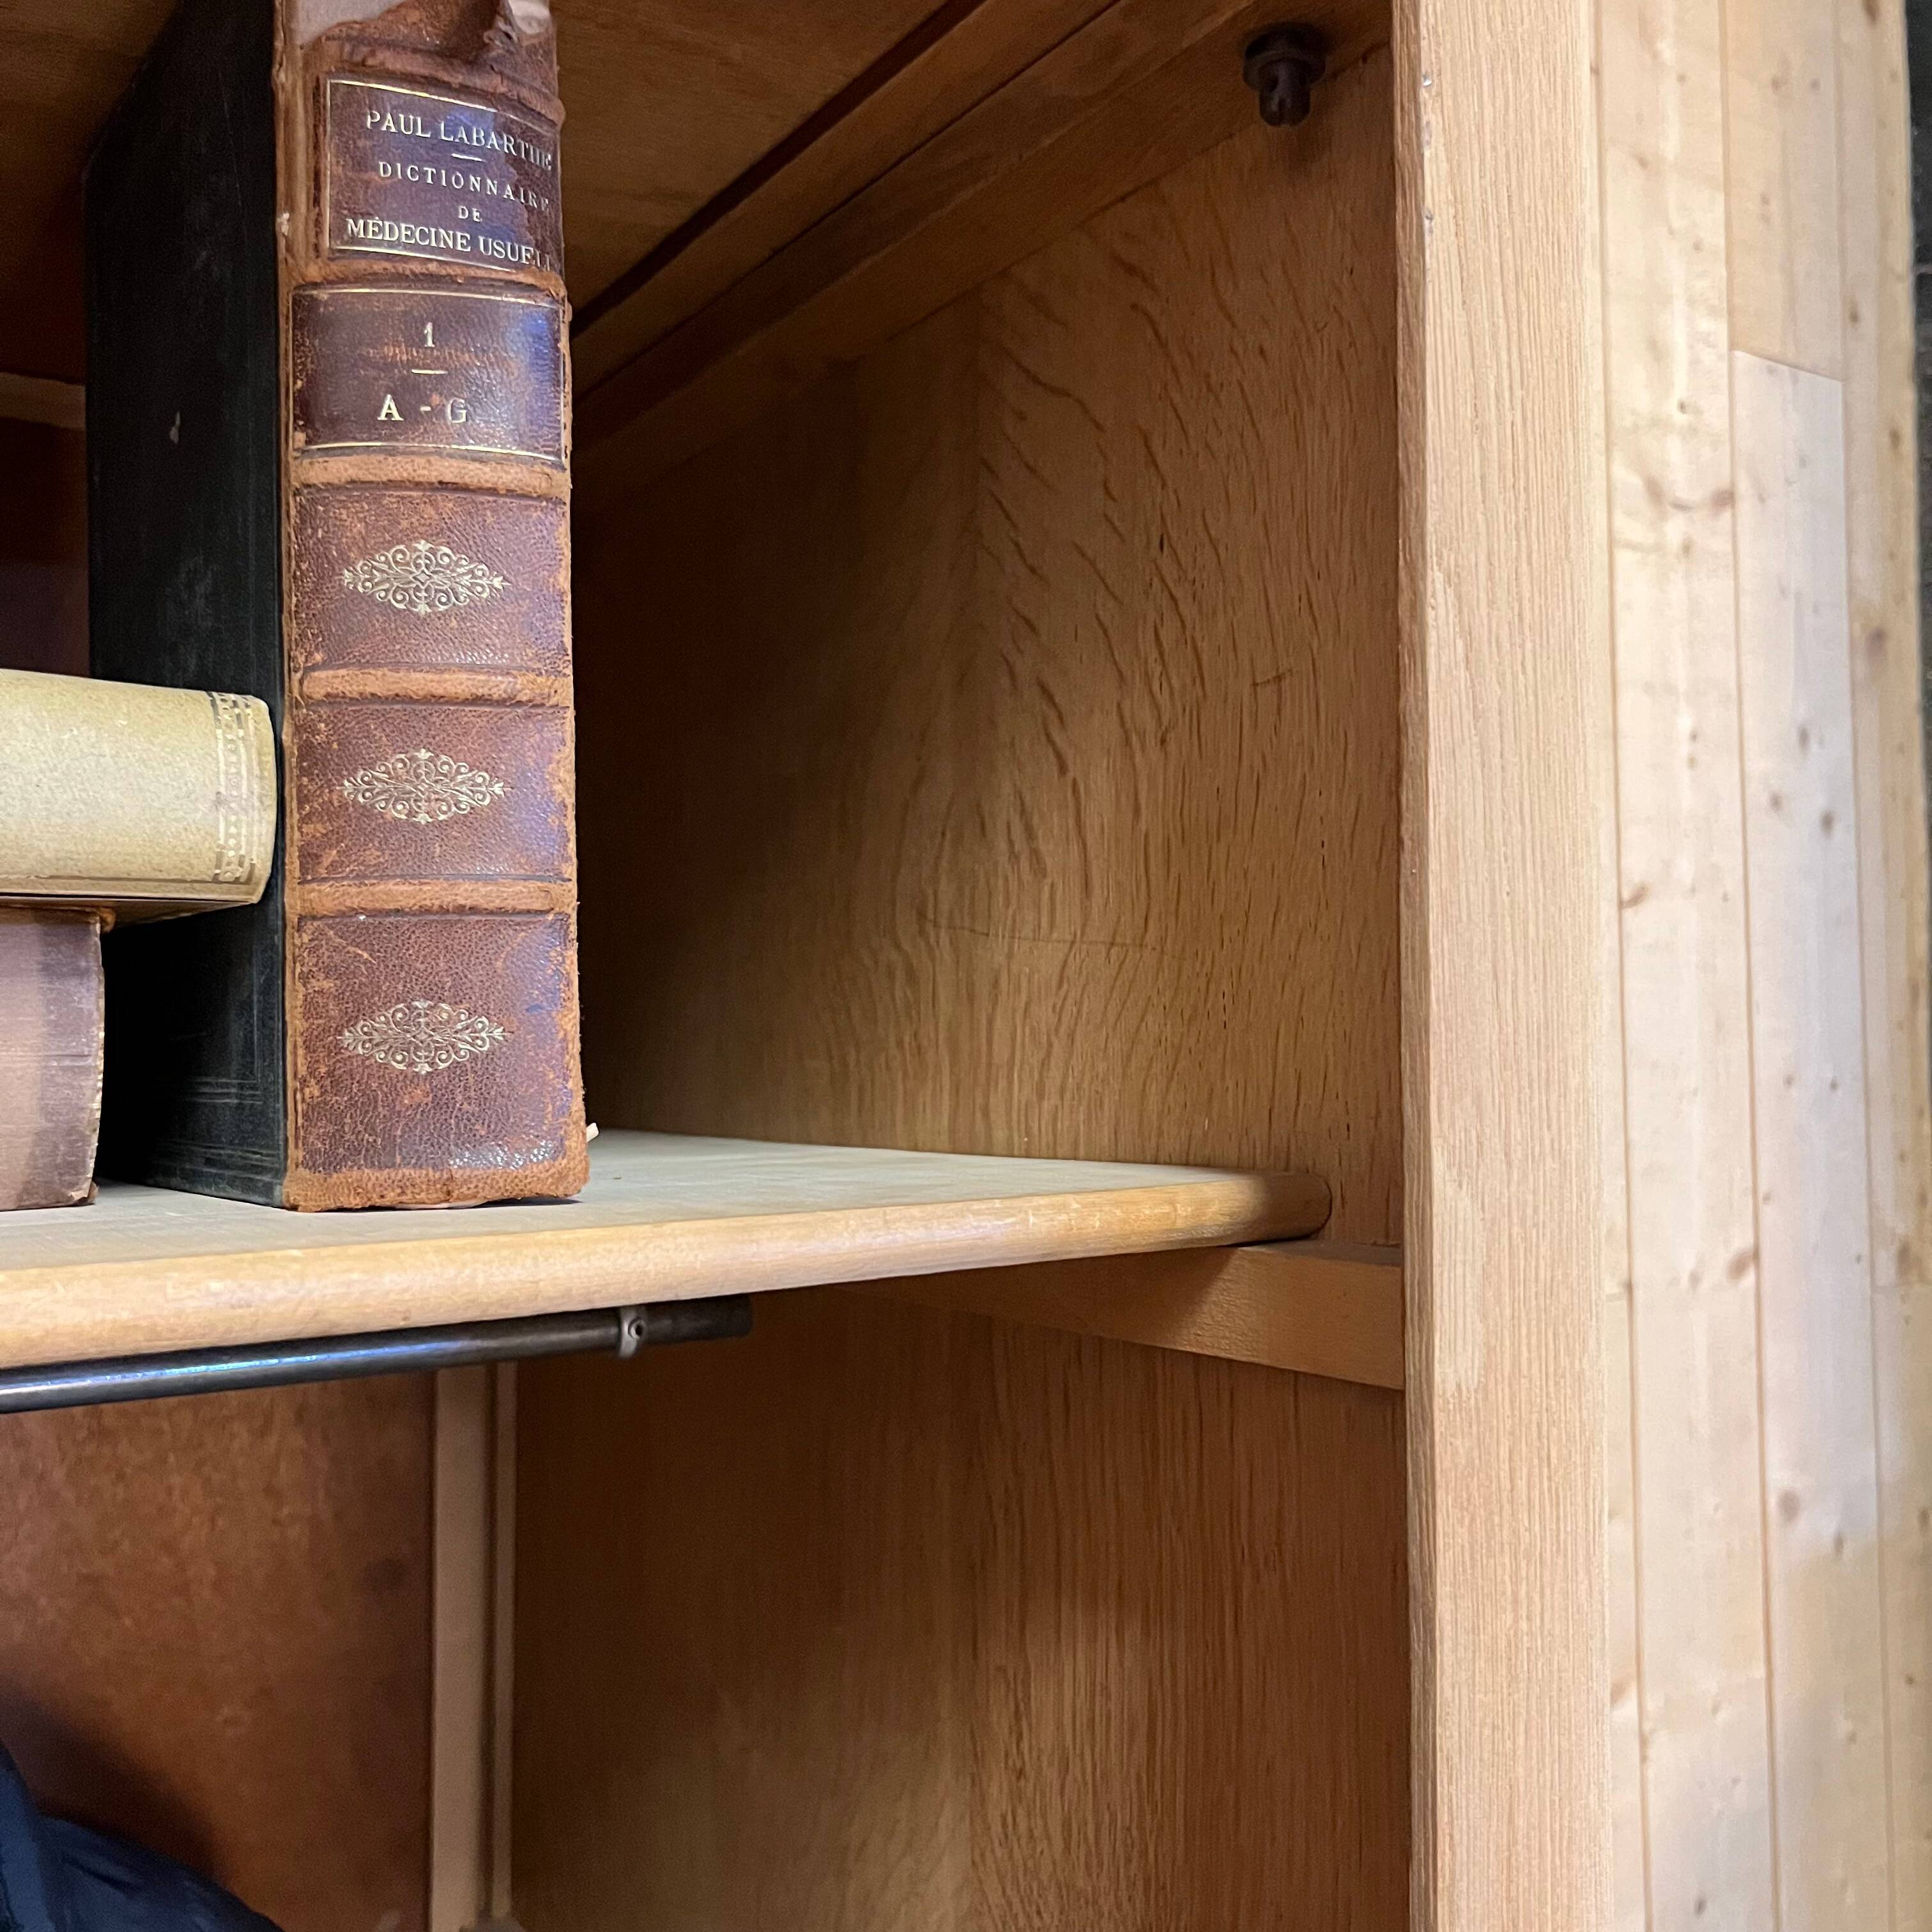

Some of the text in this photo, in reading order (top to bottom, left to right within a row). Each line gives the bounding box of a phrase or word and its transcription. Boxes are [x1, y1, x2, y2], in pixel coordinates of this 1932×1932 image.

[367, 111, 431, 138] PAUL
[458, 206, 483, 222] DE
[346, 217, 471, 252] MÉDECINE
[424, 322, 435, 348] 1
[378, 394, 404, 421] A
[447, 397, 467, 424] G
